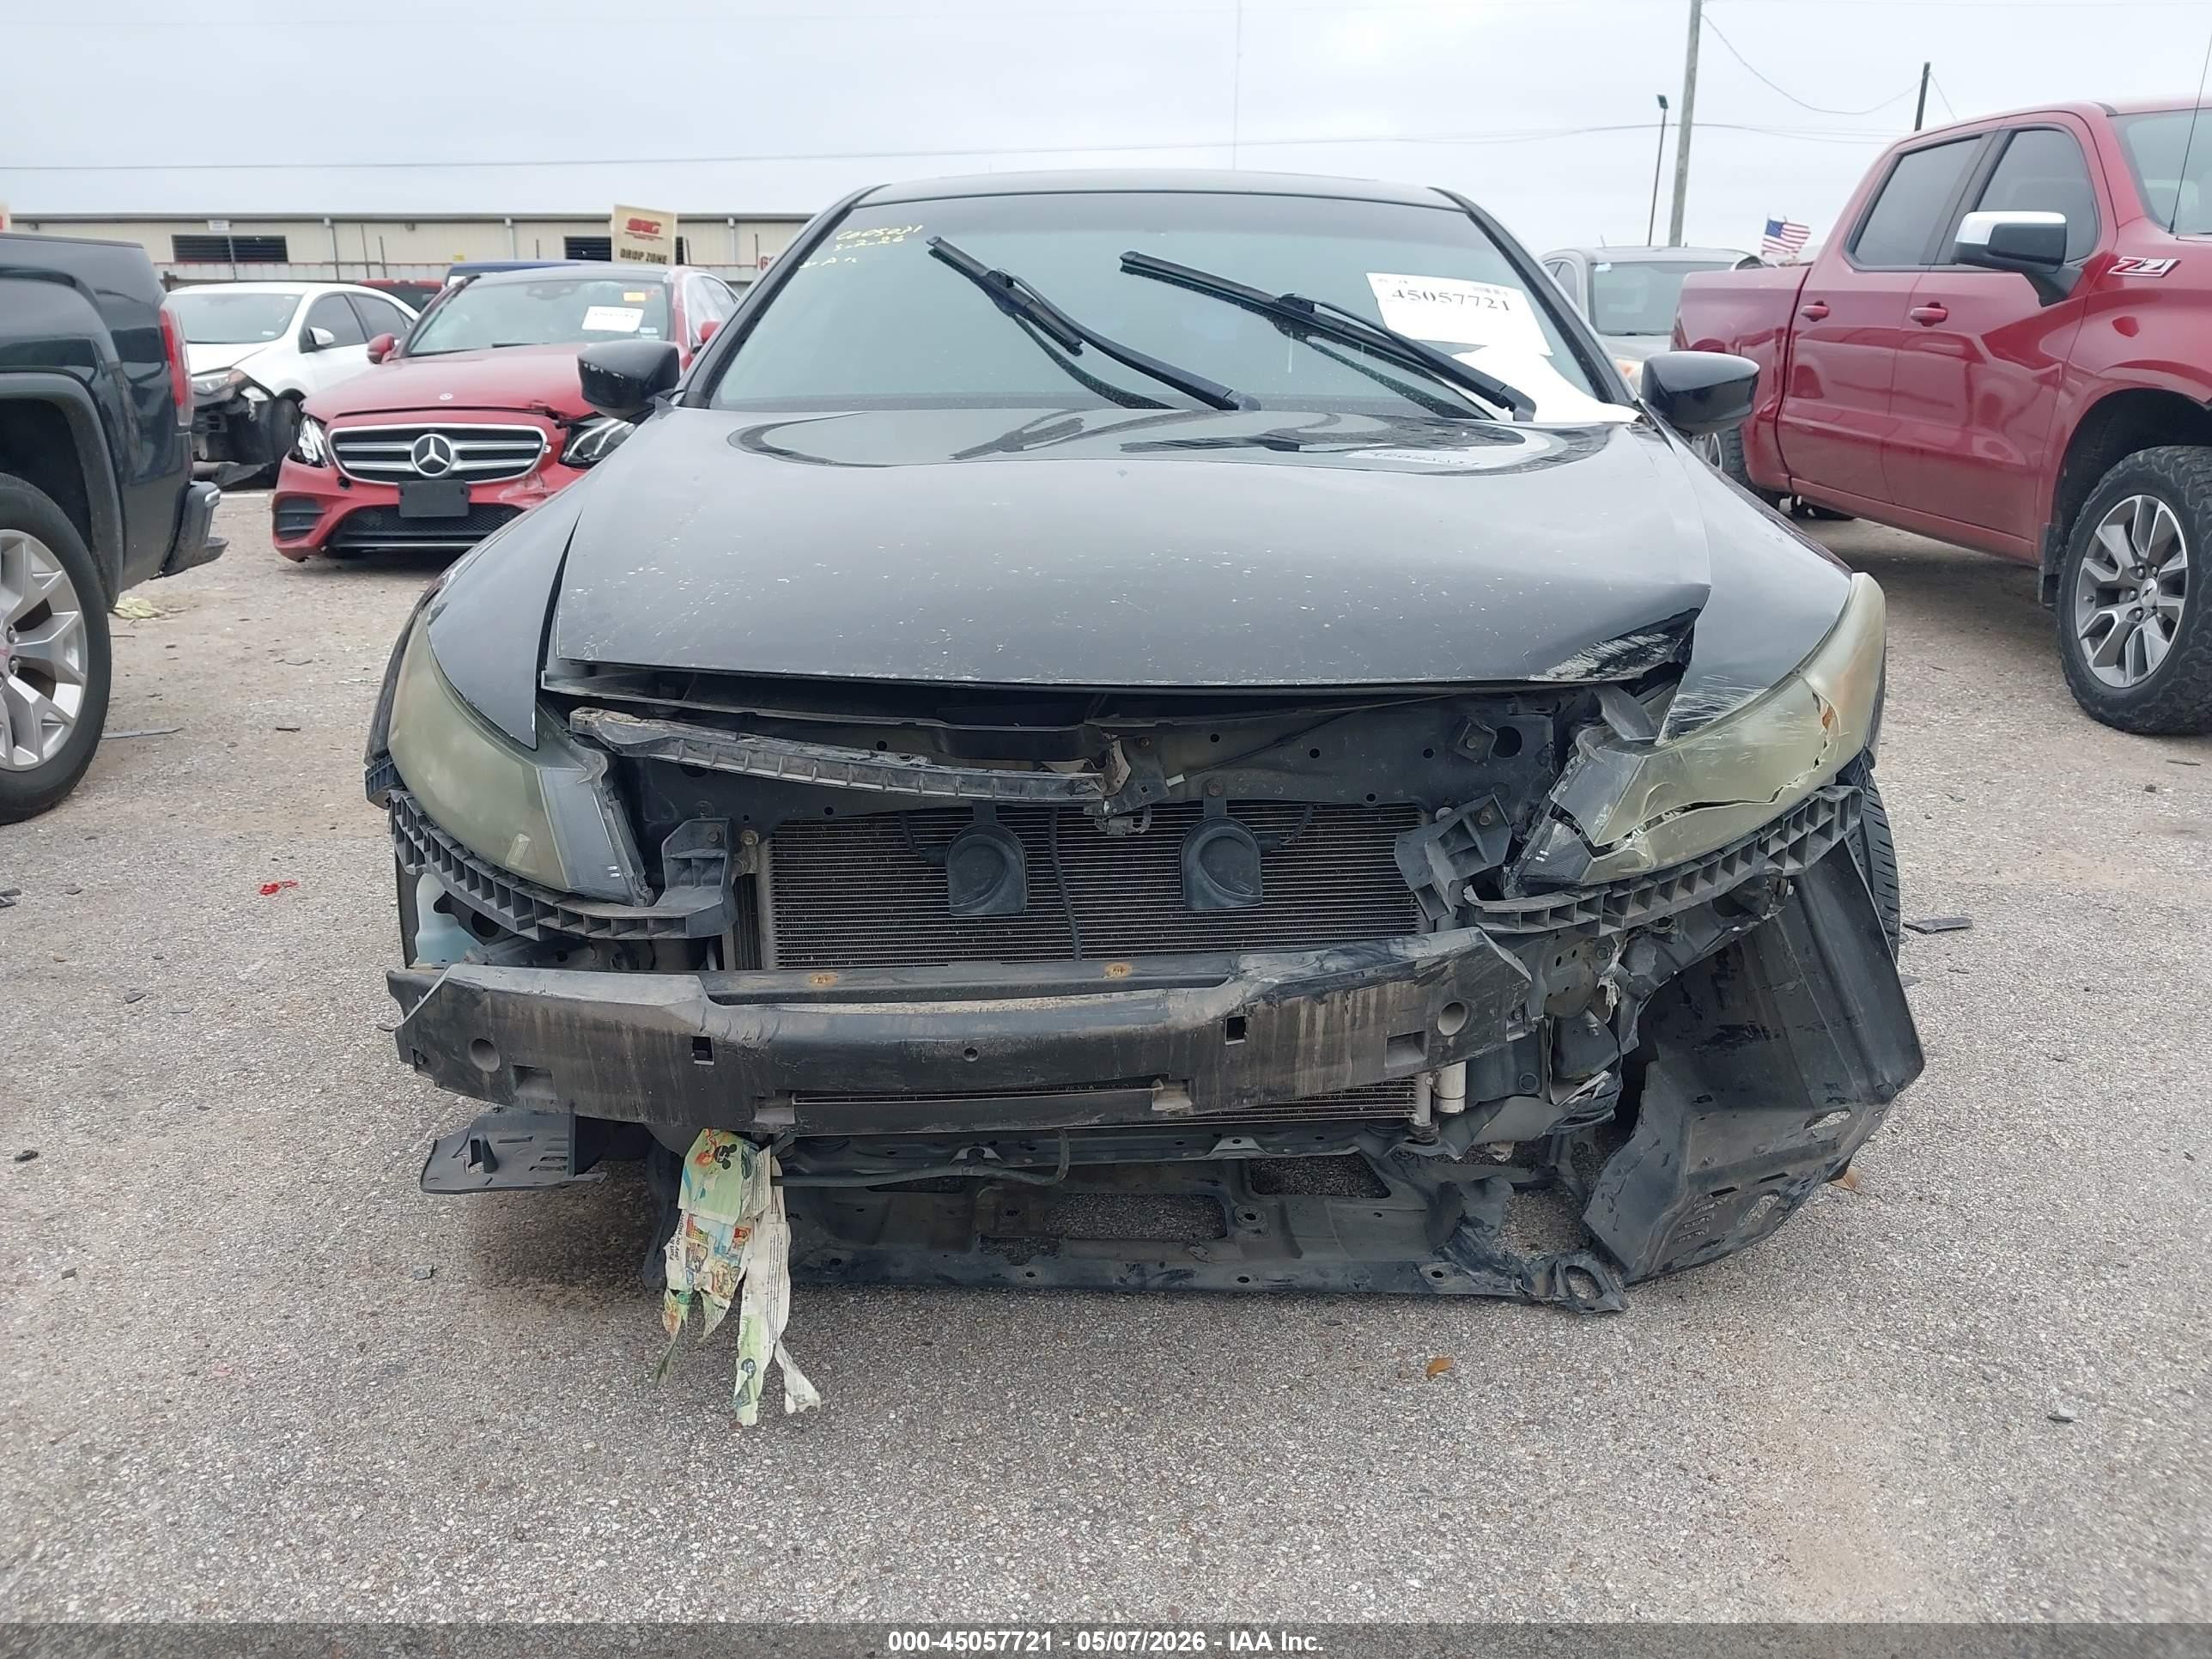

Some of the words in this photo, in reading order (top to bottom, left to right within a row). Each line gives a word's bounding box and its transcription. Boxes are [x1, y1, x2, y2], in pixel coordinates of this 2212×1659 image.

[620, 248, 645, 261] DROP
[2107, 256, 2182, 278] Z71
[1392, 289, 1510, 312] 45057721
